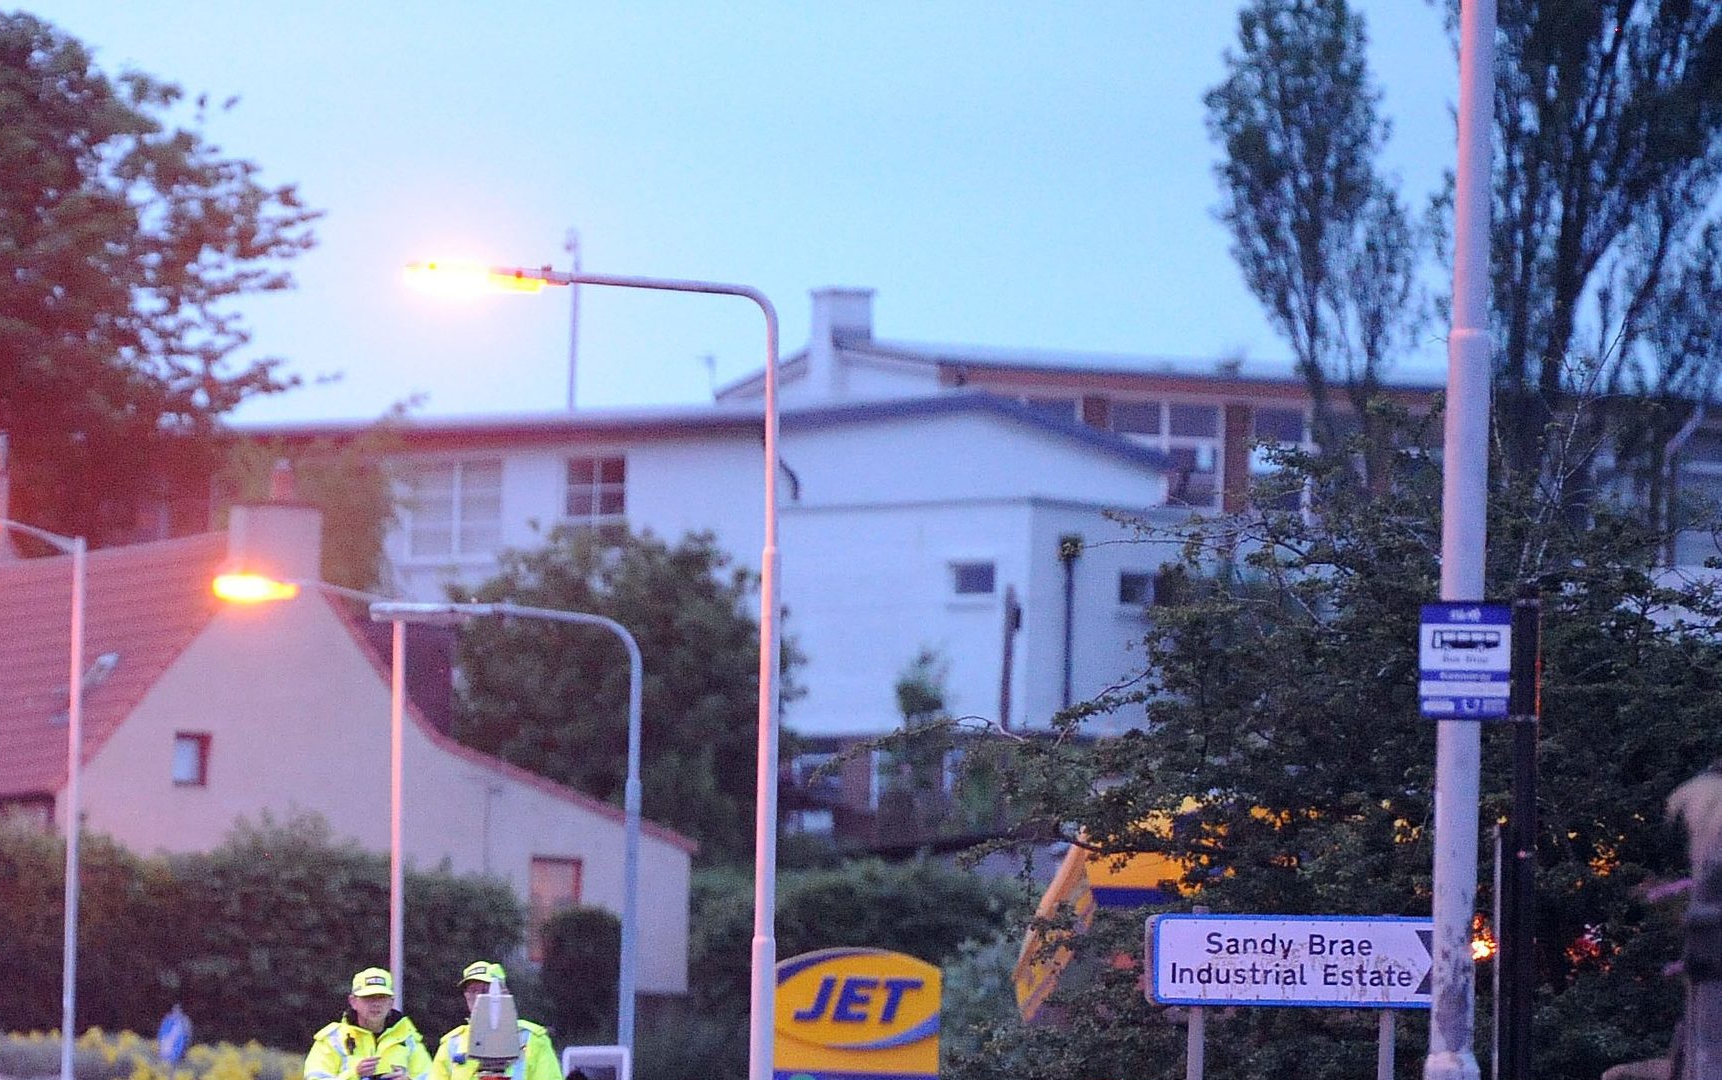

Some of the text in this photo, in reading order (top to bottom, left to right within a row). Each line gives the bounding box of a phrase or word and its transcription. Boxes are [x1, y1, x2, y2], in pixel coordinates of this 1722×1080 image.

[1205, 932, 1373, 959] Sandy Brae
[1170, 962, 1413, 988] Industrial Estate
[793, 975, 925, 1024] JET
